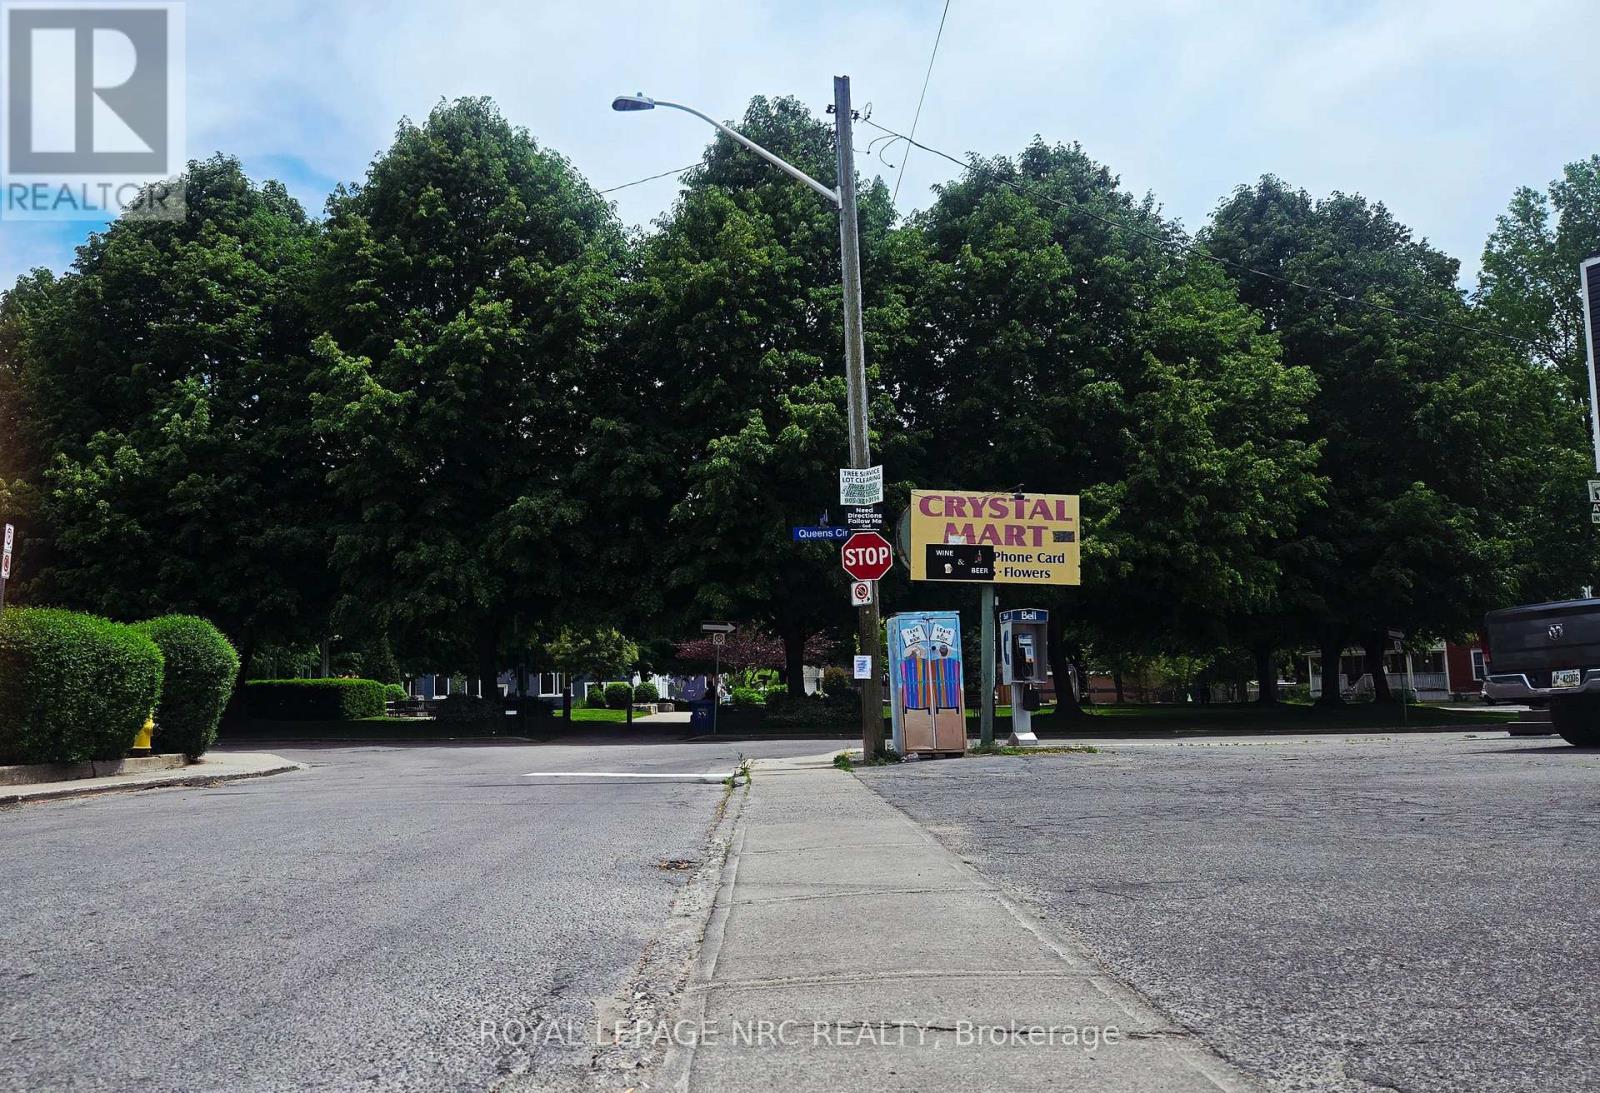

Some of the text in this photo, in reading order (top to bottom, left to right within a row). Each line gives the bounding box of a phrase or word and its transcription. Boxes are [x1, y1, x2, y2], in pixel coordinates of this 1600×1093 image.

[859, 468, 880, 477] SERVICE
[855, 474, 881, 483] CLEARING
[919, 495, 1072, 521] CRYSTAL
[798, 529, 848, 538] Queens Cir
[944, 522, 1048, 547] MART
[845, 547, 889, 566] STOP
[957, 558, 965, 566] &
[994, 551, 1065, 564] Phone Card
[1004, 566, 1051, 579] Flowers
[1021, 611, 1037, 620] Bell
